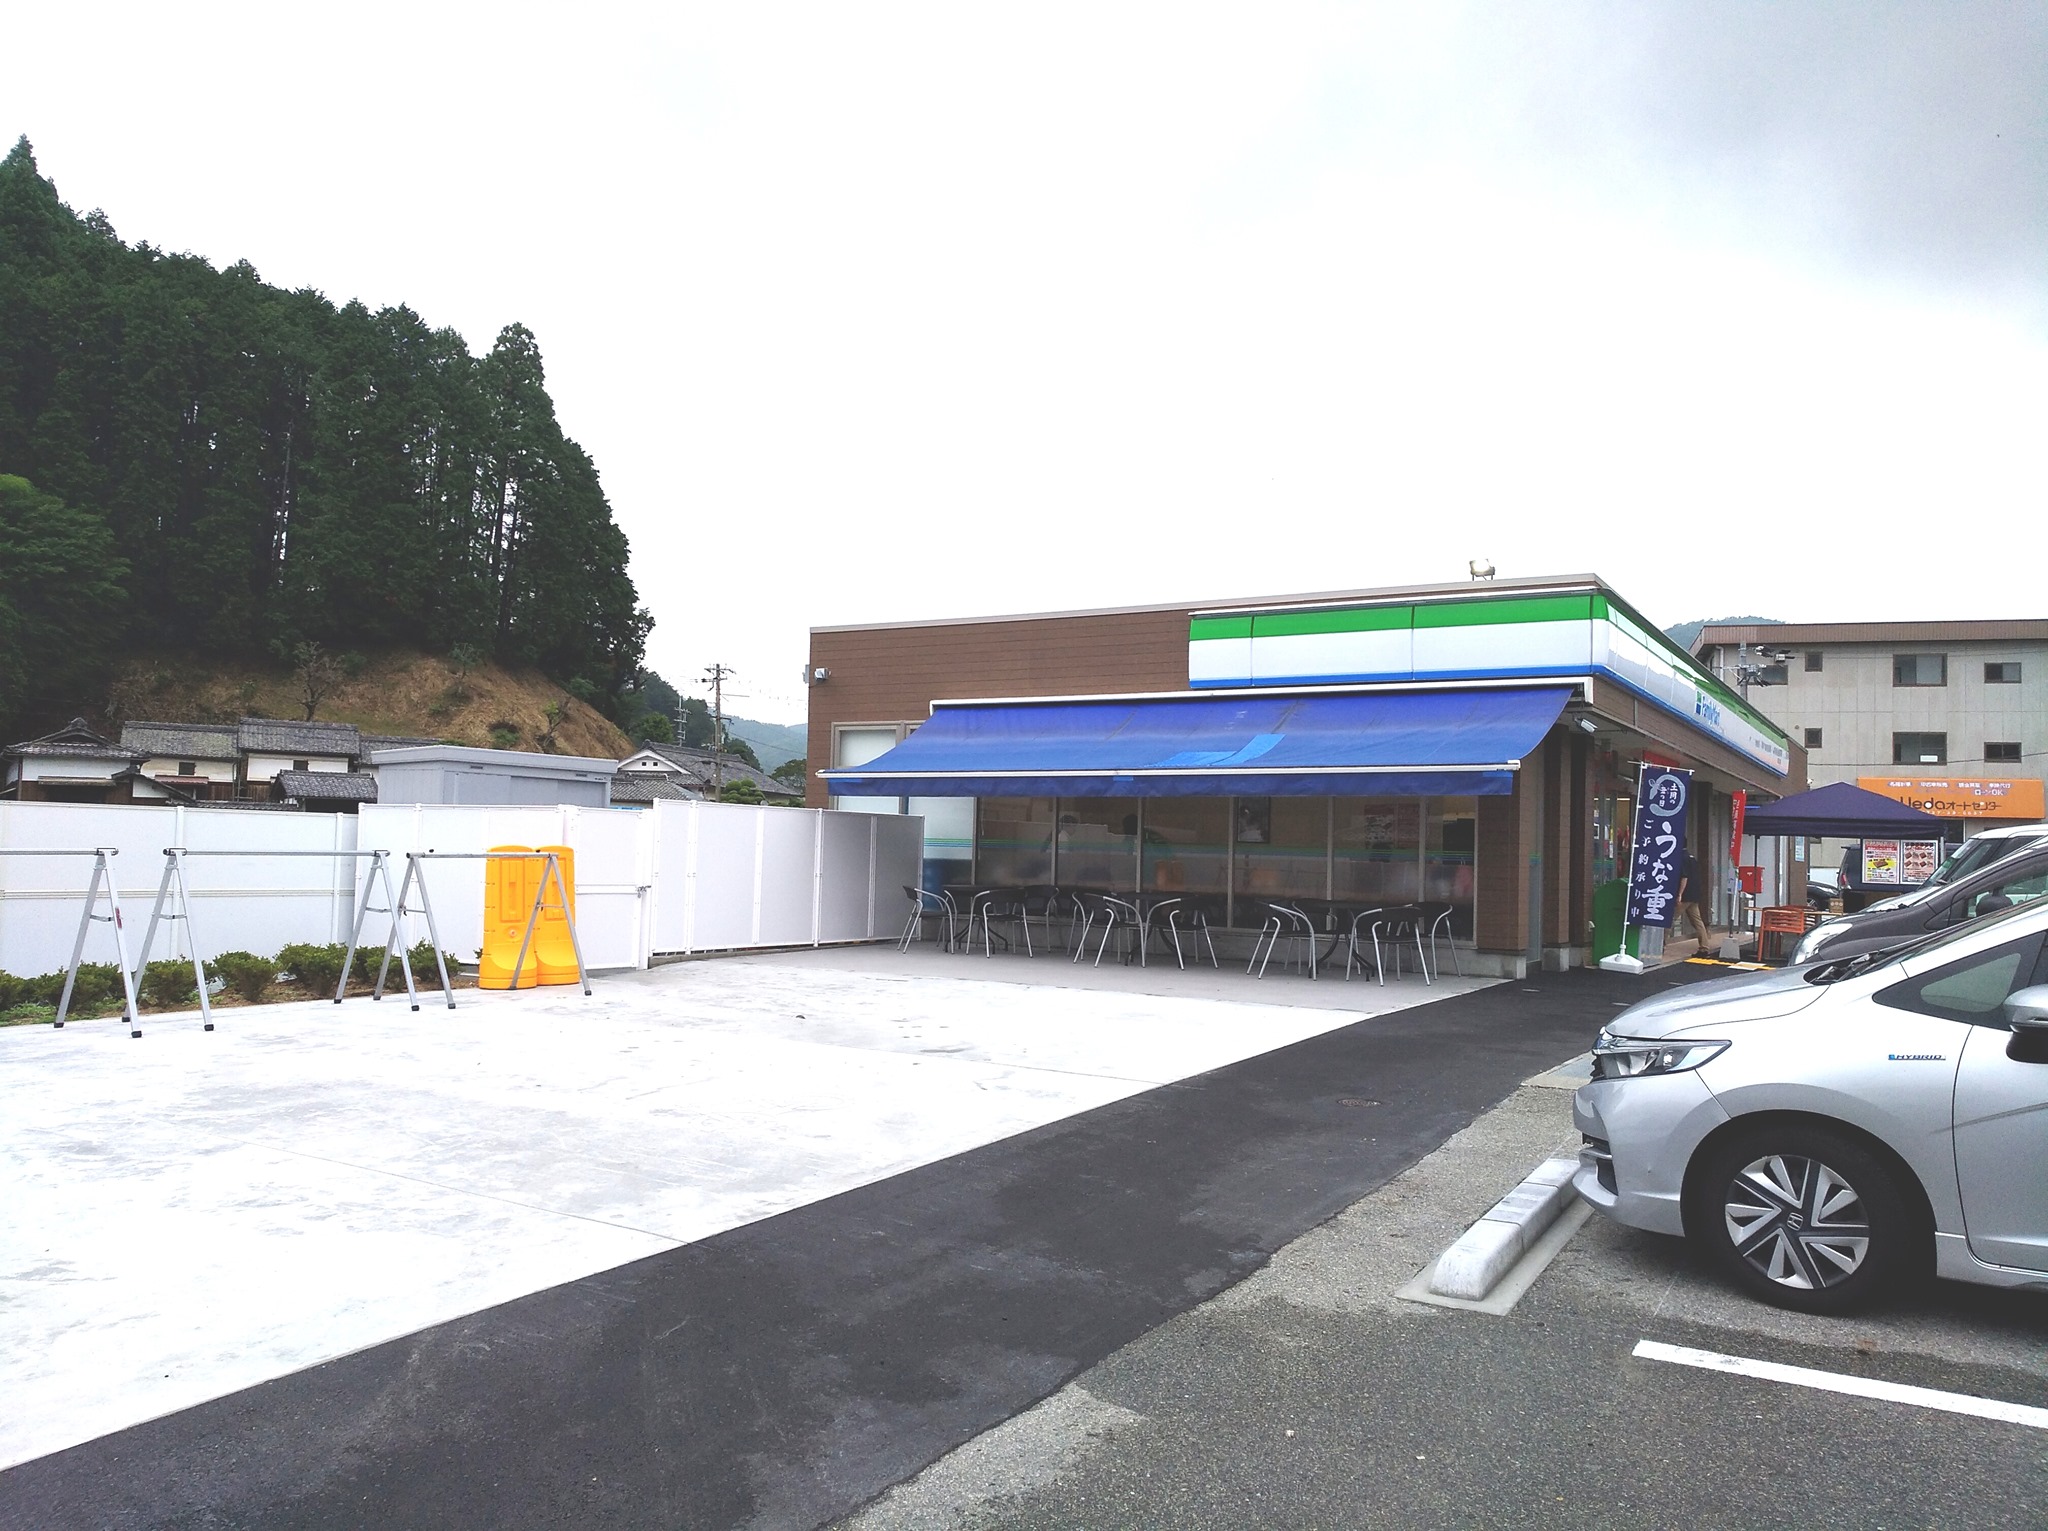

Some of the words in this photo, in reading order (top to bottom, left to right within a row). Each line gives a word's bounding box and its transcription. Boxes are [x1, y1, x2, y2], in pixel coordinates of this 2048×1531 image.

[1669, 783, 1678, 804] 土用の
[1630, 819, 1654, 918] ご予約承り中
[1641, 821, 1677, 921] うな重
